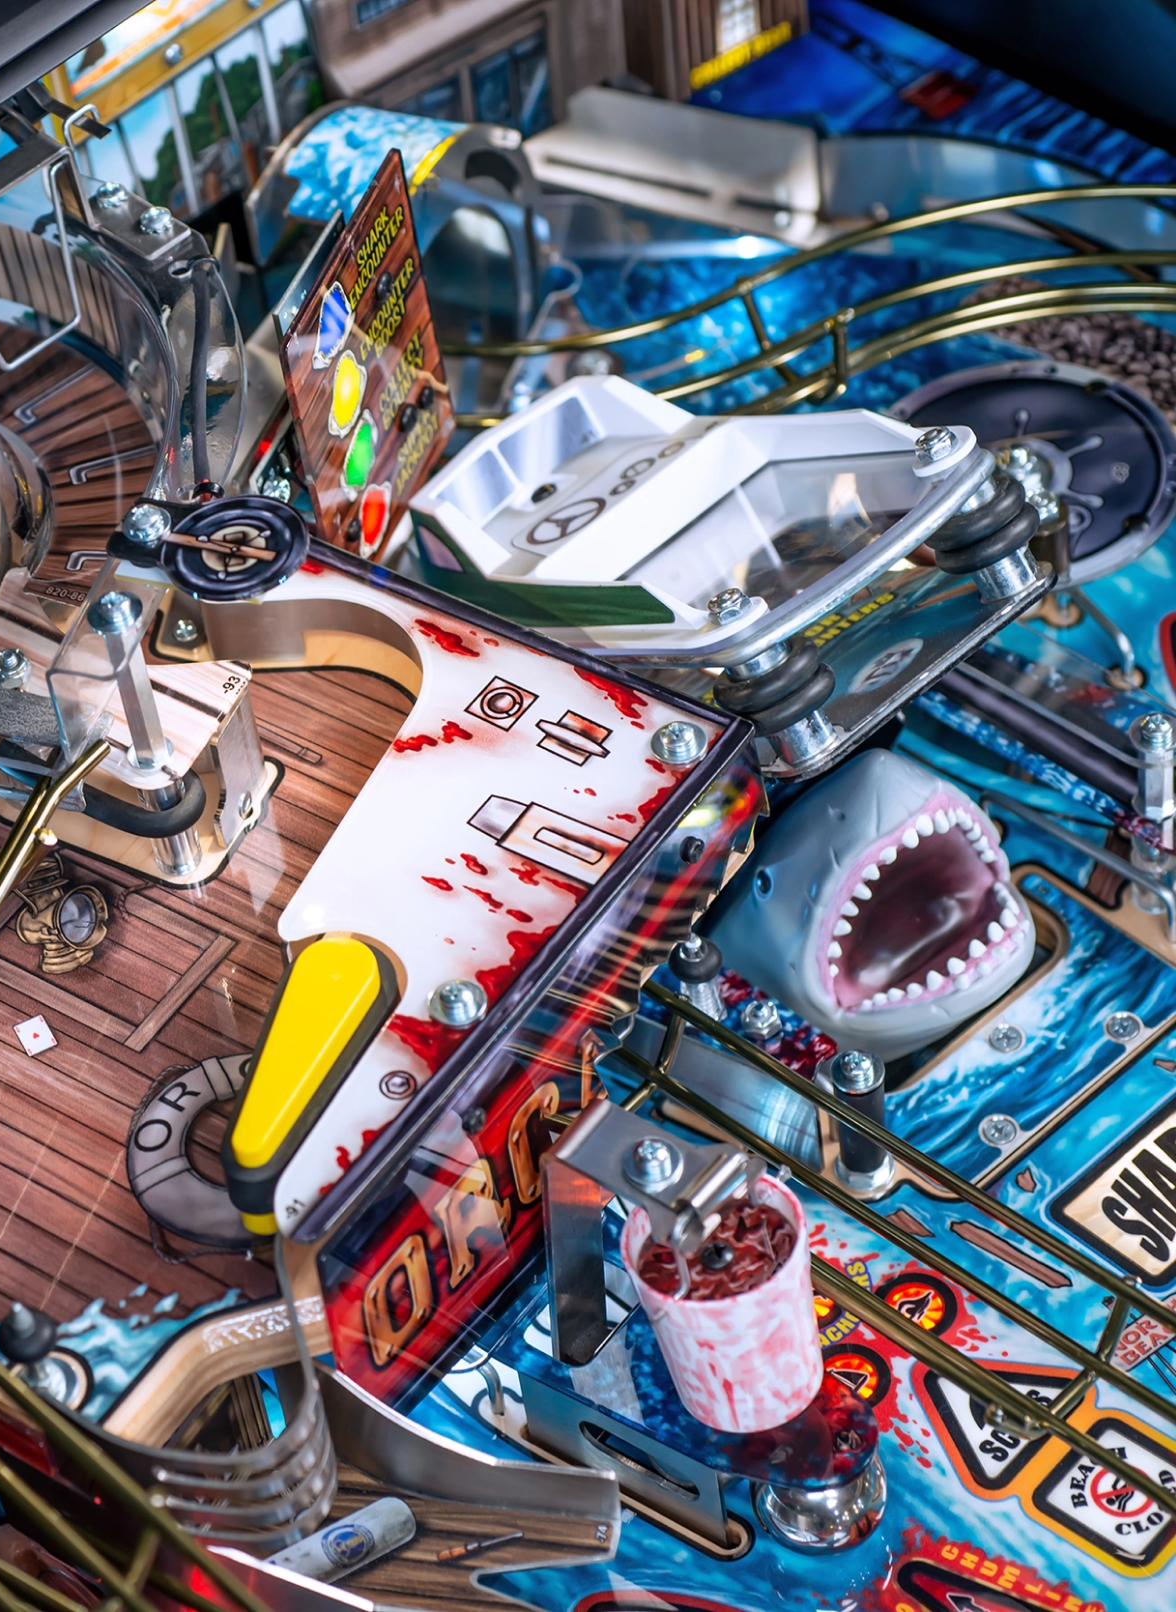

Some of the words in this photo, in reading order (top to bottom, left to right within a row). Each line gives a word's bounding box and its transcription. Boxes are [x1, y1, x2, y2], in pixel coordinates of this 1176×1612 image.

[349, 206, 404, 311] ENCOUNTER
[356, 207, 389, 271] SHARK
[360, 257, 414, 362] ENCOUNTER
[375, 293, 407, 359] BOOST
[379, 328, 422, 413] COLLECT
[382, 348, 423, 431] BOUNTY
[395, 411, 439, 497] JACKPOT
[222, 675, 241, 694] -93
[285, 1198, 306, 1219] -91
[940, 1544, 1021, 1590] CHUM
